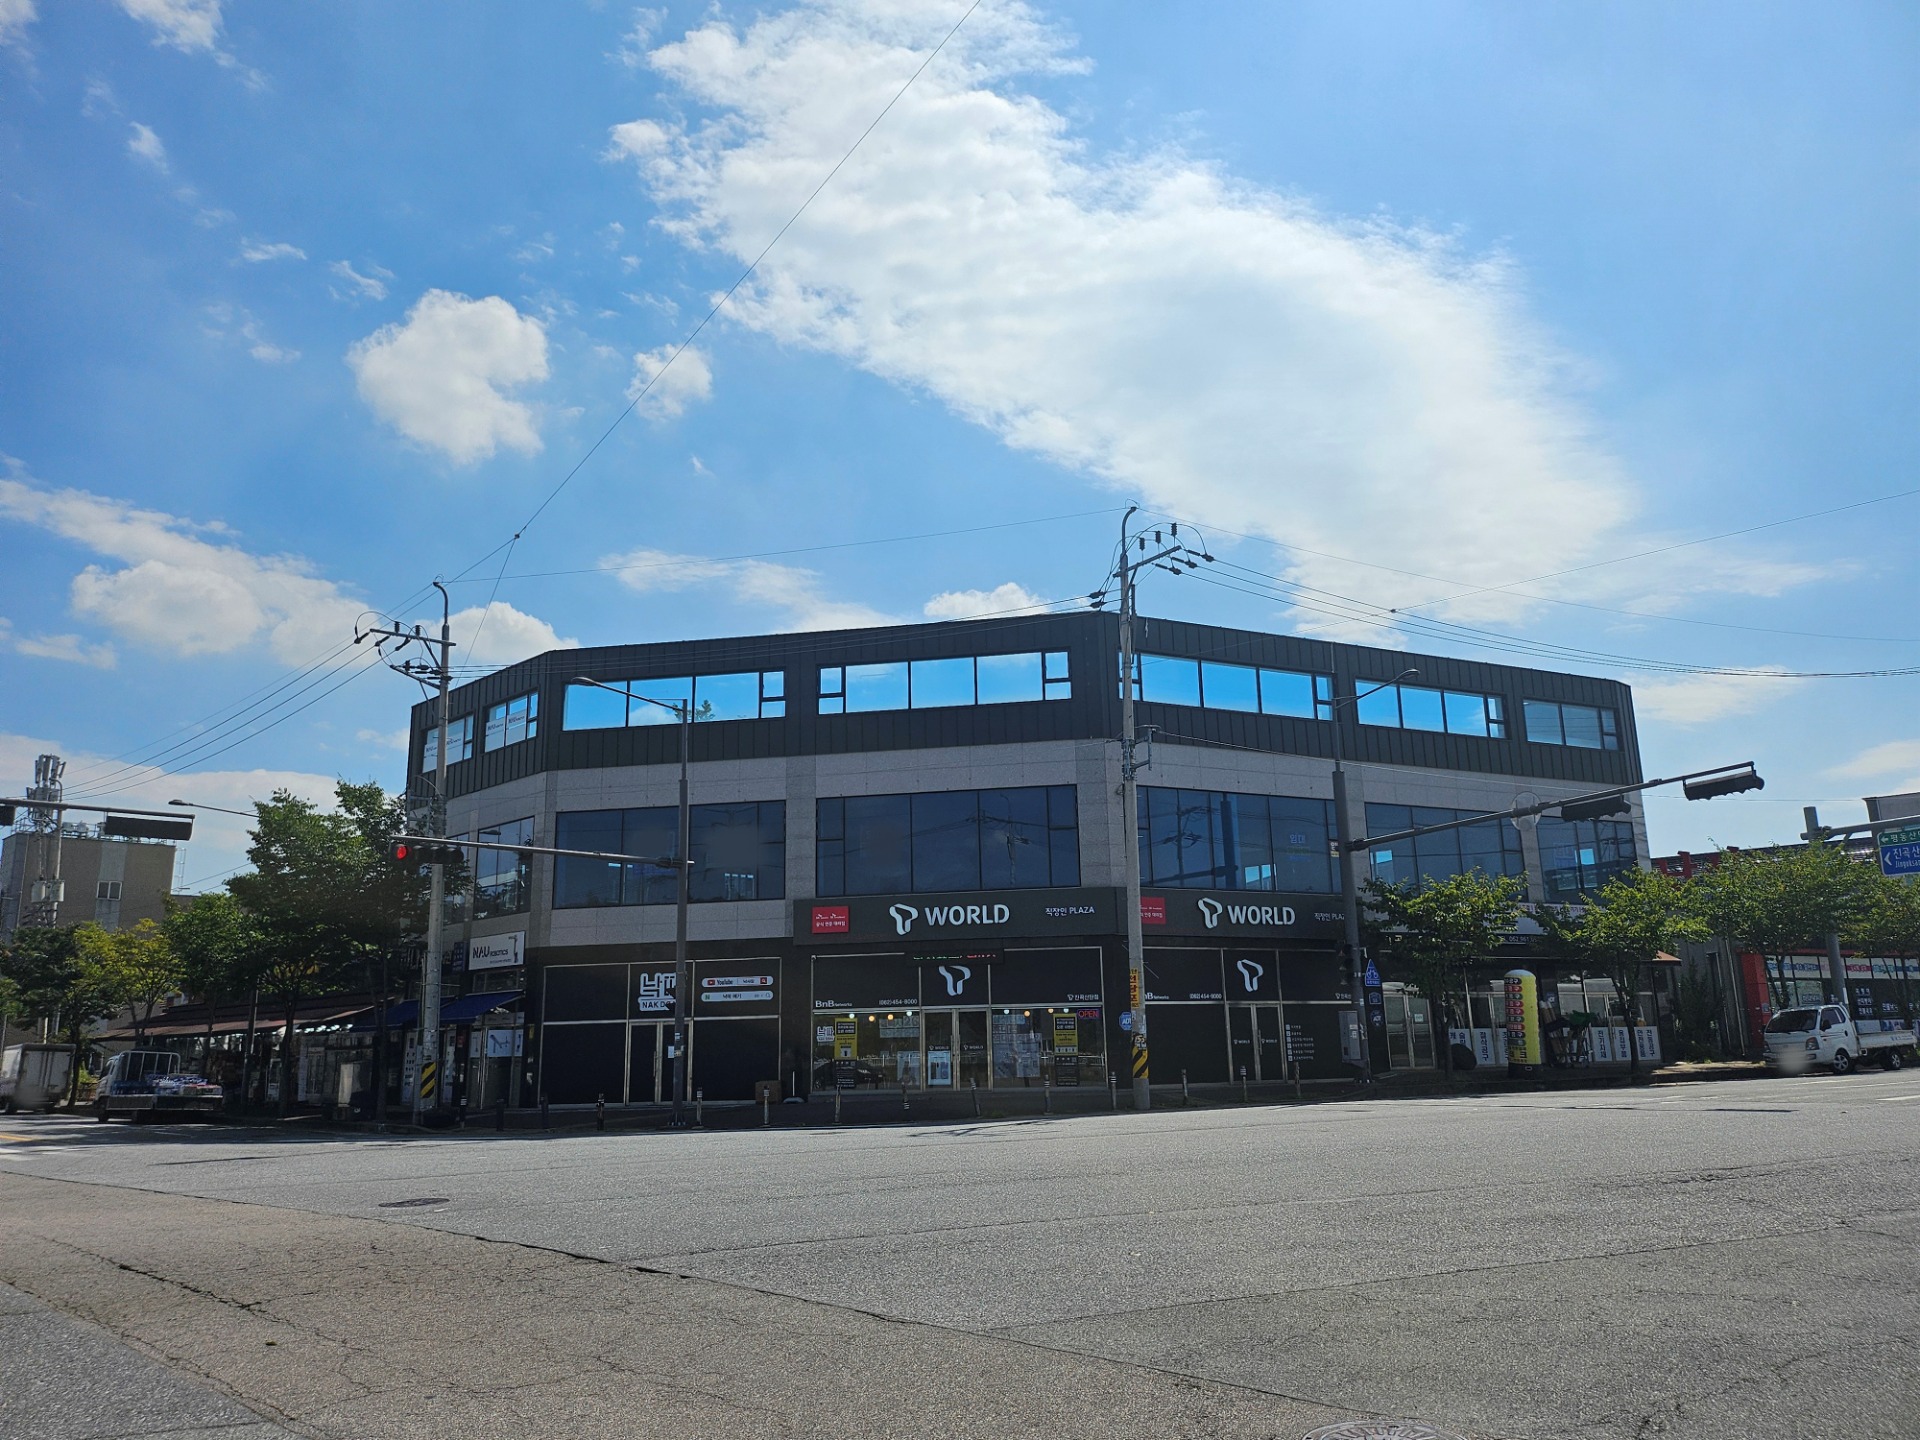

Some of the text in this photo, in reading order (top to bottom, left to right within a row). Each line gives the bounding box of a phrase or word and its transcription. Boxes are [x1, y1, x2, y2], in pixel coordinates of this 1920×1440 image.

[1890, 831, 1920, 842] 평동산
[924, 903, 1010, 926] WORLD
[1045, 906, 1095, 917] 직장인 PLAZA
[1227, 904, 1296, 925] WORLD
[1078, 1010, 1098, 1018] OPEN
